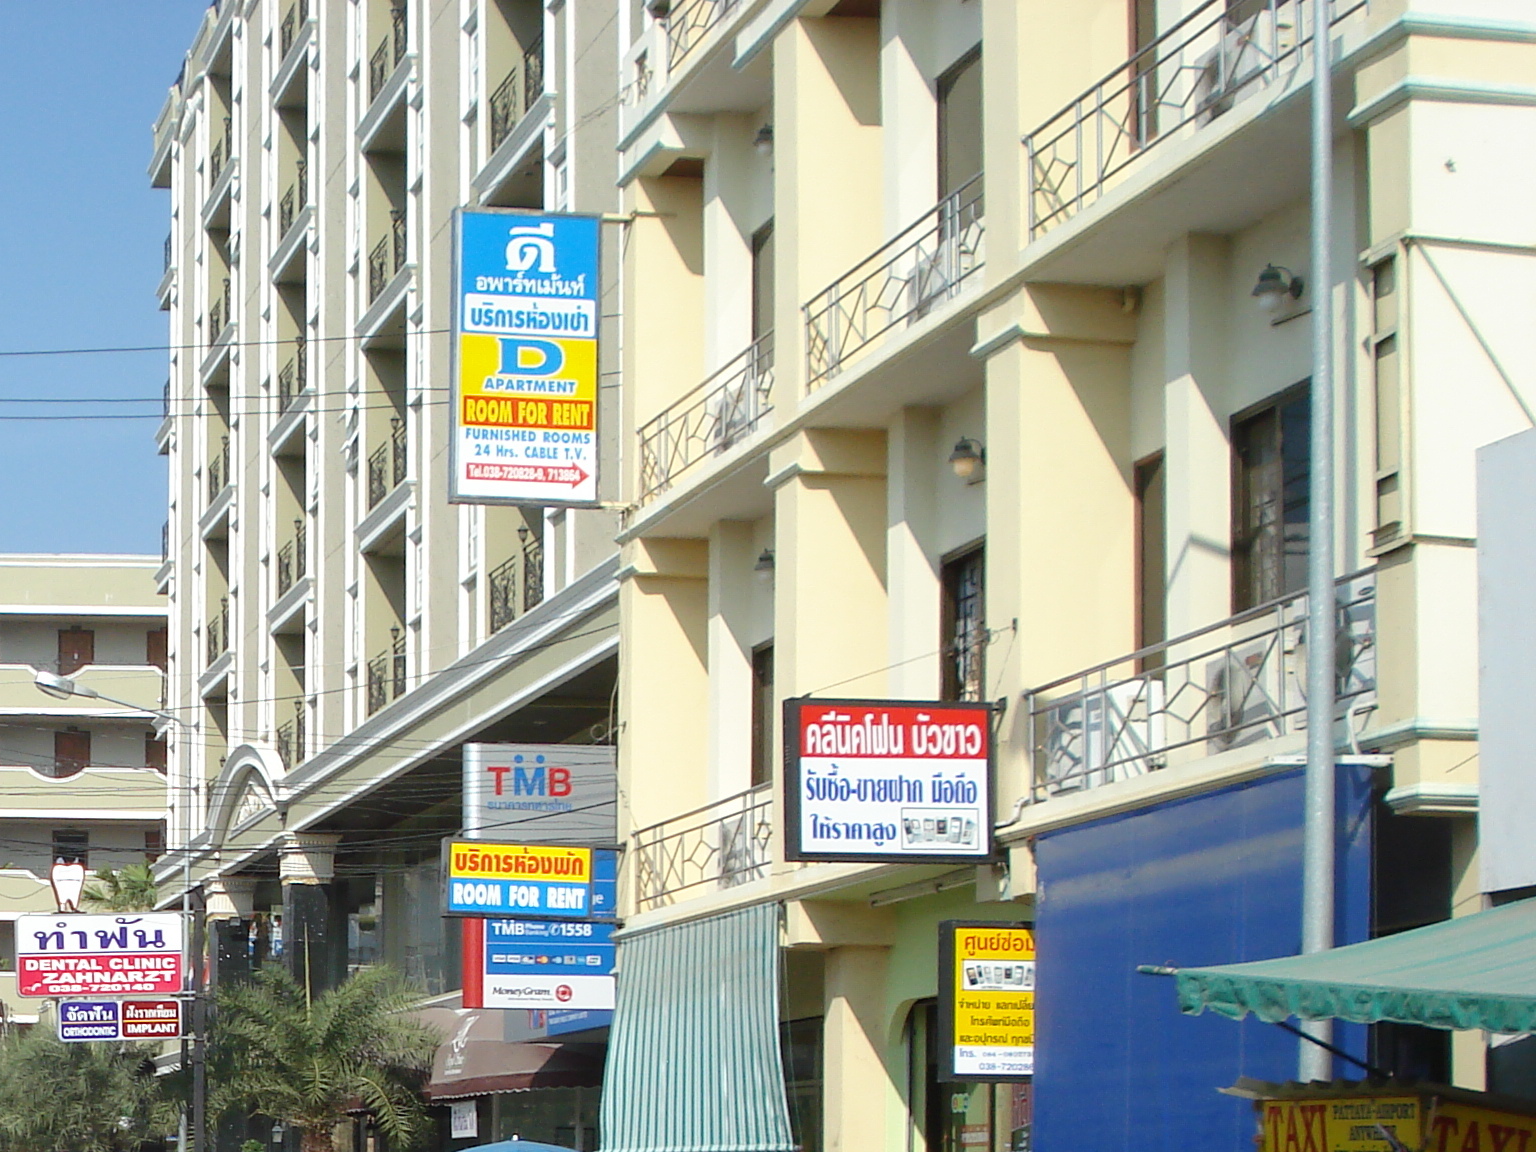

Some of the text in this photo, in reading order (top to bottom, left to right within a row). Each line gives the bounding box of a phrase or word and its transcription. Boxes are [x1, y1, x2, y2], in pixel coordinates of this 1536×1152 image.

[506, 222, 556, 272] ดี
[471, 302, 588, 331] บริการห้องเช่า
[498, 337, 563, 376] D
[484, 378, 575, 393] APARTMENT
[466, 399, 589, 426] ROOM FOR RENT
[466, 428, 590, 444] FURNISHED ROOMS
[475, 444, 587, 460] 24 Hrs. CABLE T.V.
[912, 713, 982, 755] บัวขาว
[487, 755, 573, 797] TMB
[932, 772, 978, 803] มือถือ
[809, 813, 897, 846] ให้ราคาสูง
[455, 847, 584, 876] บริการห้องพัก
[453, 883, 502, 906] ROOM
[508, 885, 540, 908] FOR
[546, 887, 586, 909] RENT
[34, 917, 166, 950] ทำฟัน
[491, 920, 525, 936] TMB
[559, 923, 592, 937] 1558
[25, 957, 176, 971] DENTAL CLINIC
[42, 971, 176, 984] ZAHNARZT
[48, 983, 155, 993] 038-720140
[492, 986, 552, 998] MoneyGram
[66, 1005, 113, 1021] จัดฟัน
[127, 1023, 176, 1034] IMPLANT
